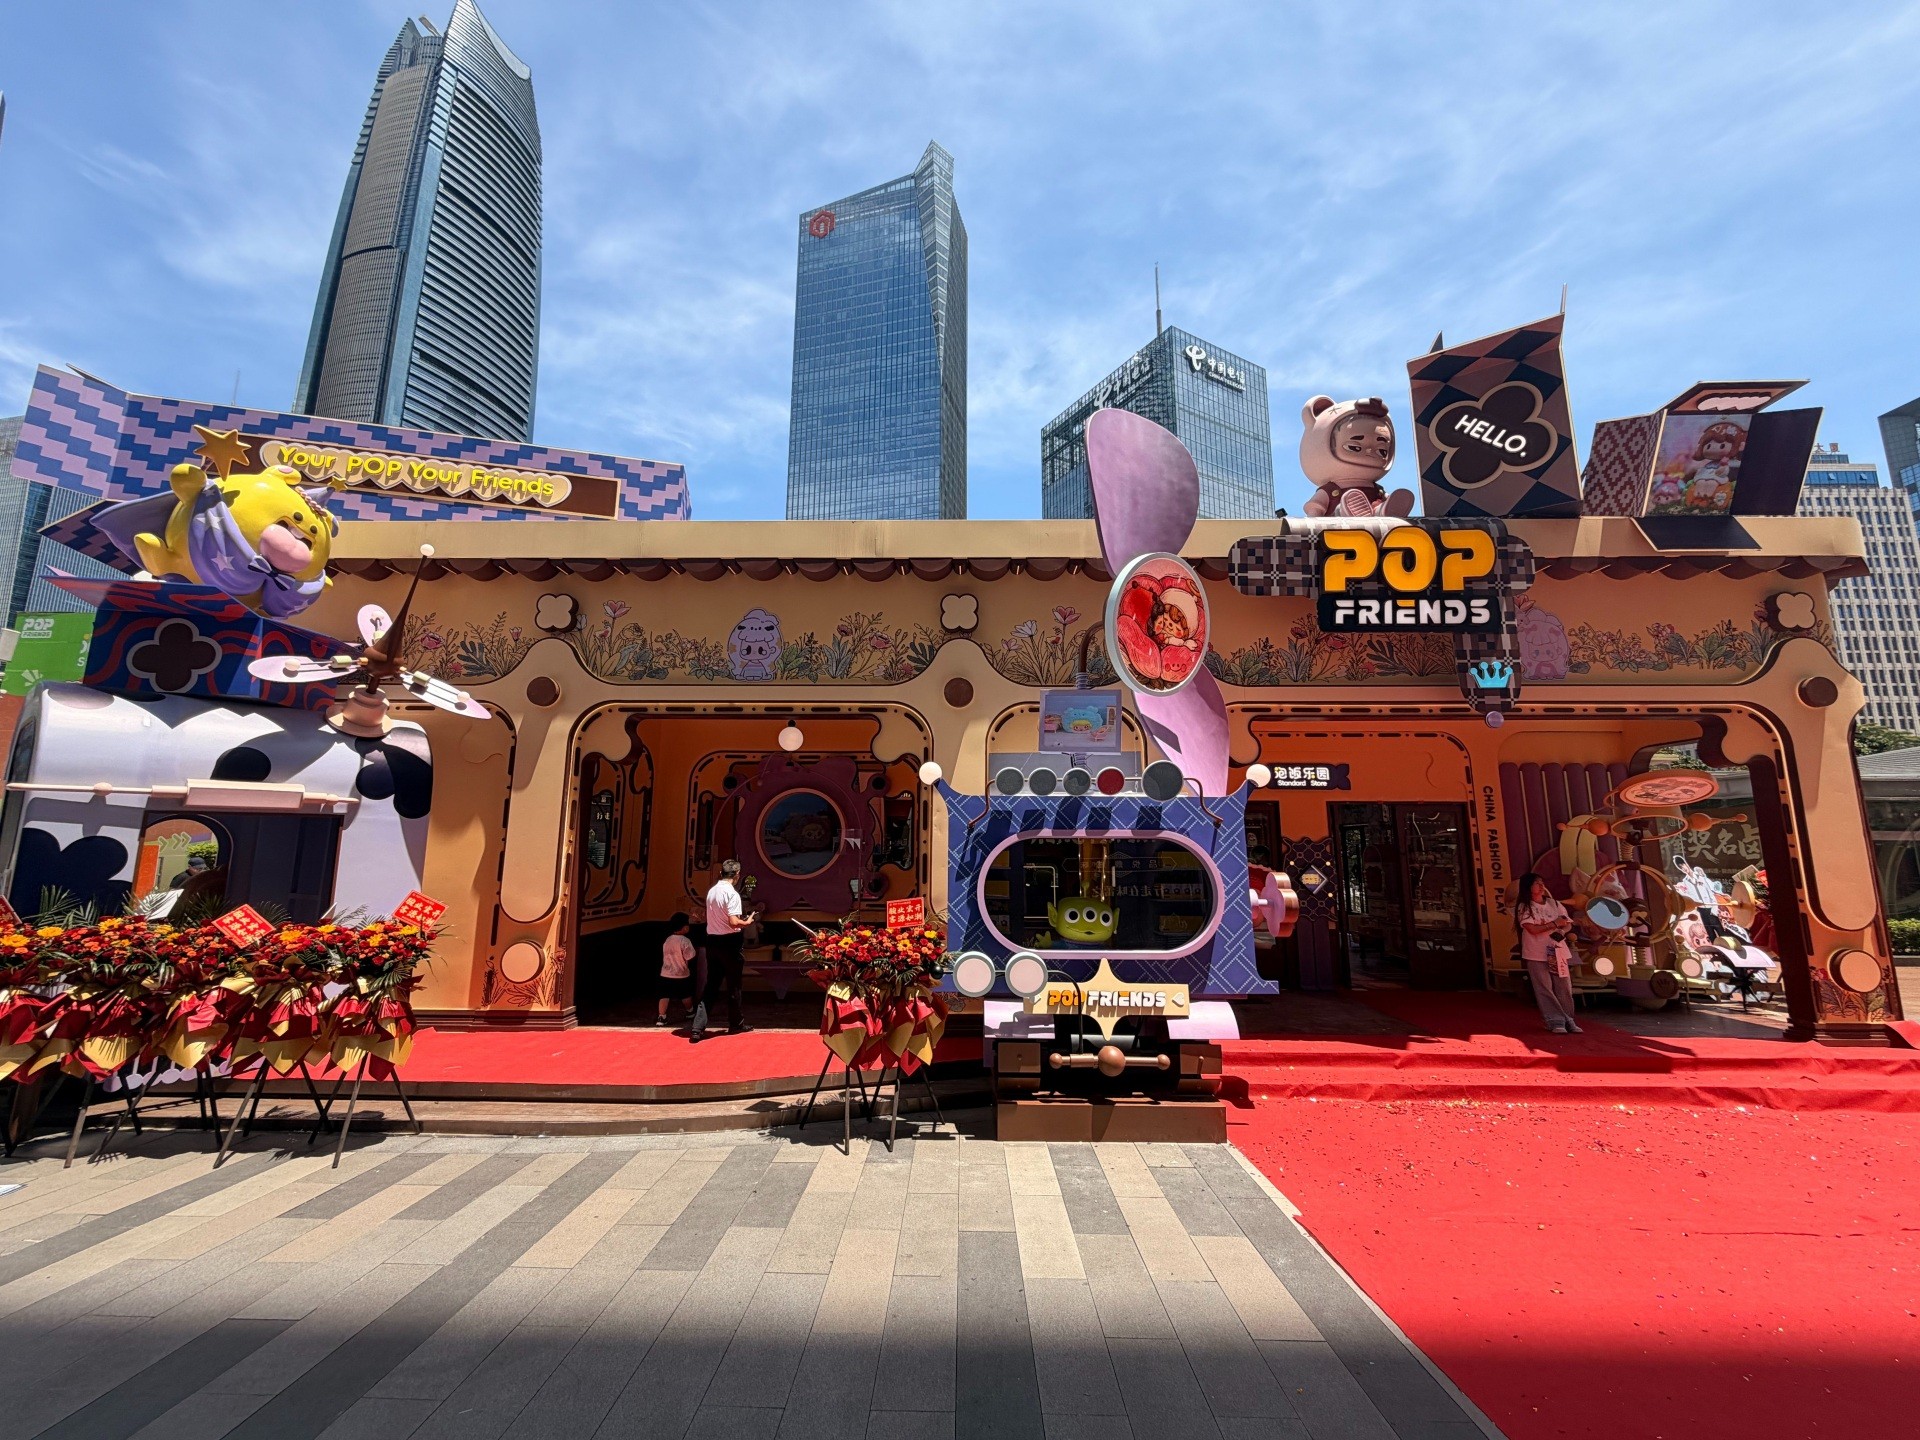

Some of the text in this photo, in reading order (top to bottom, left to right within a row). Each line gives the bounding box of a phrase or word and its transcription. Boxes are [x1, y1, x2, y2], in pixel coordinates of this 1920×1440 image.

[1207, 356, 1246, 384] 中国电信
[1208, 371, 1247, 391] CHINA TELECOM
[1454, 414, 1527, 457] HELLO.
[279, 446, 555, 496] Your POP Your Friends
[1322, 526, 1496, 592] POP
[1335, 599, 1491, 625] FRIENDS
[23, 618, 55, 630] POP
[1274, 766, 1330, 780] 泡饭乐园
[1482, 785, 1508, 916] CHINA FASHION PLAY
[888, 904, 922, 915] 骏业宏开
[889, 913, 922, 924] 客源如潮
[1048, 990, 1166, 1008] POP FRIENDS
